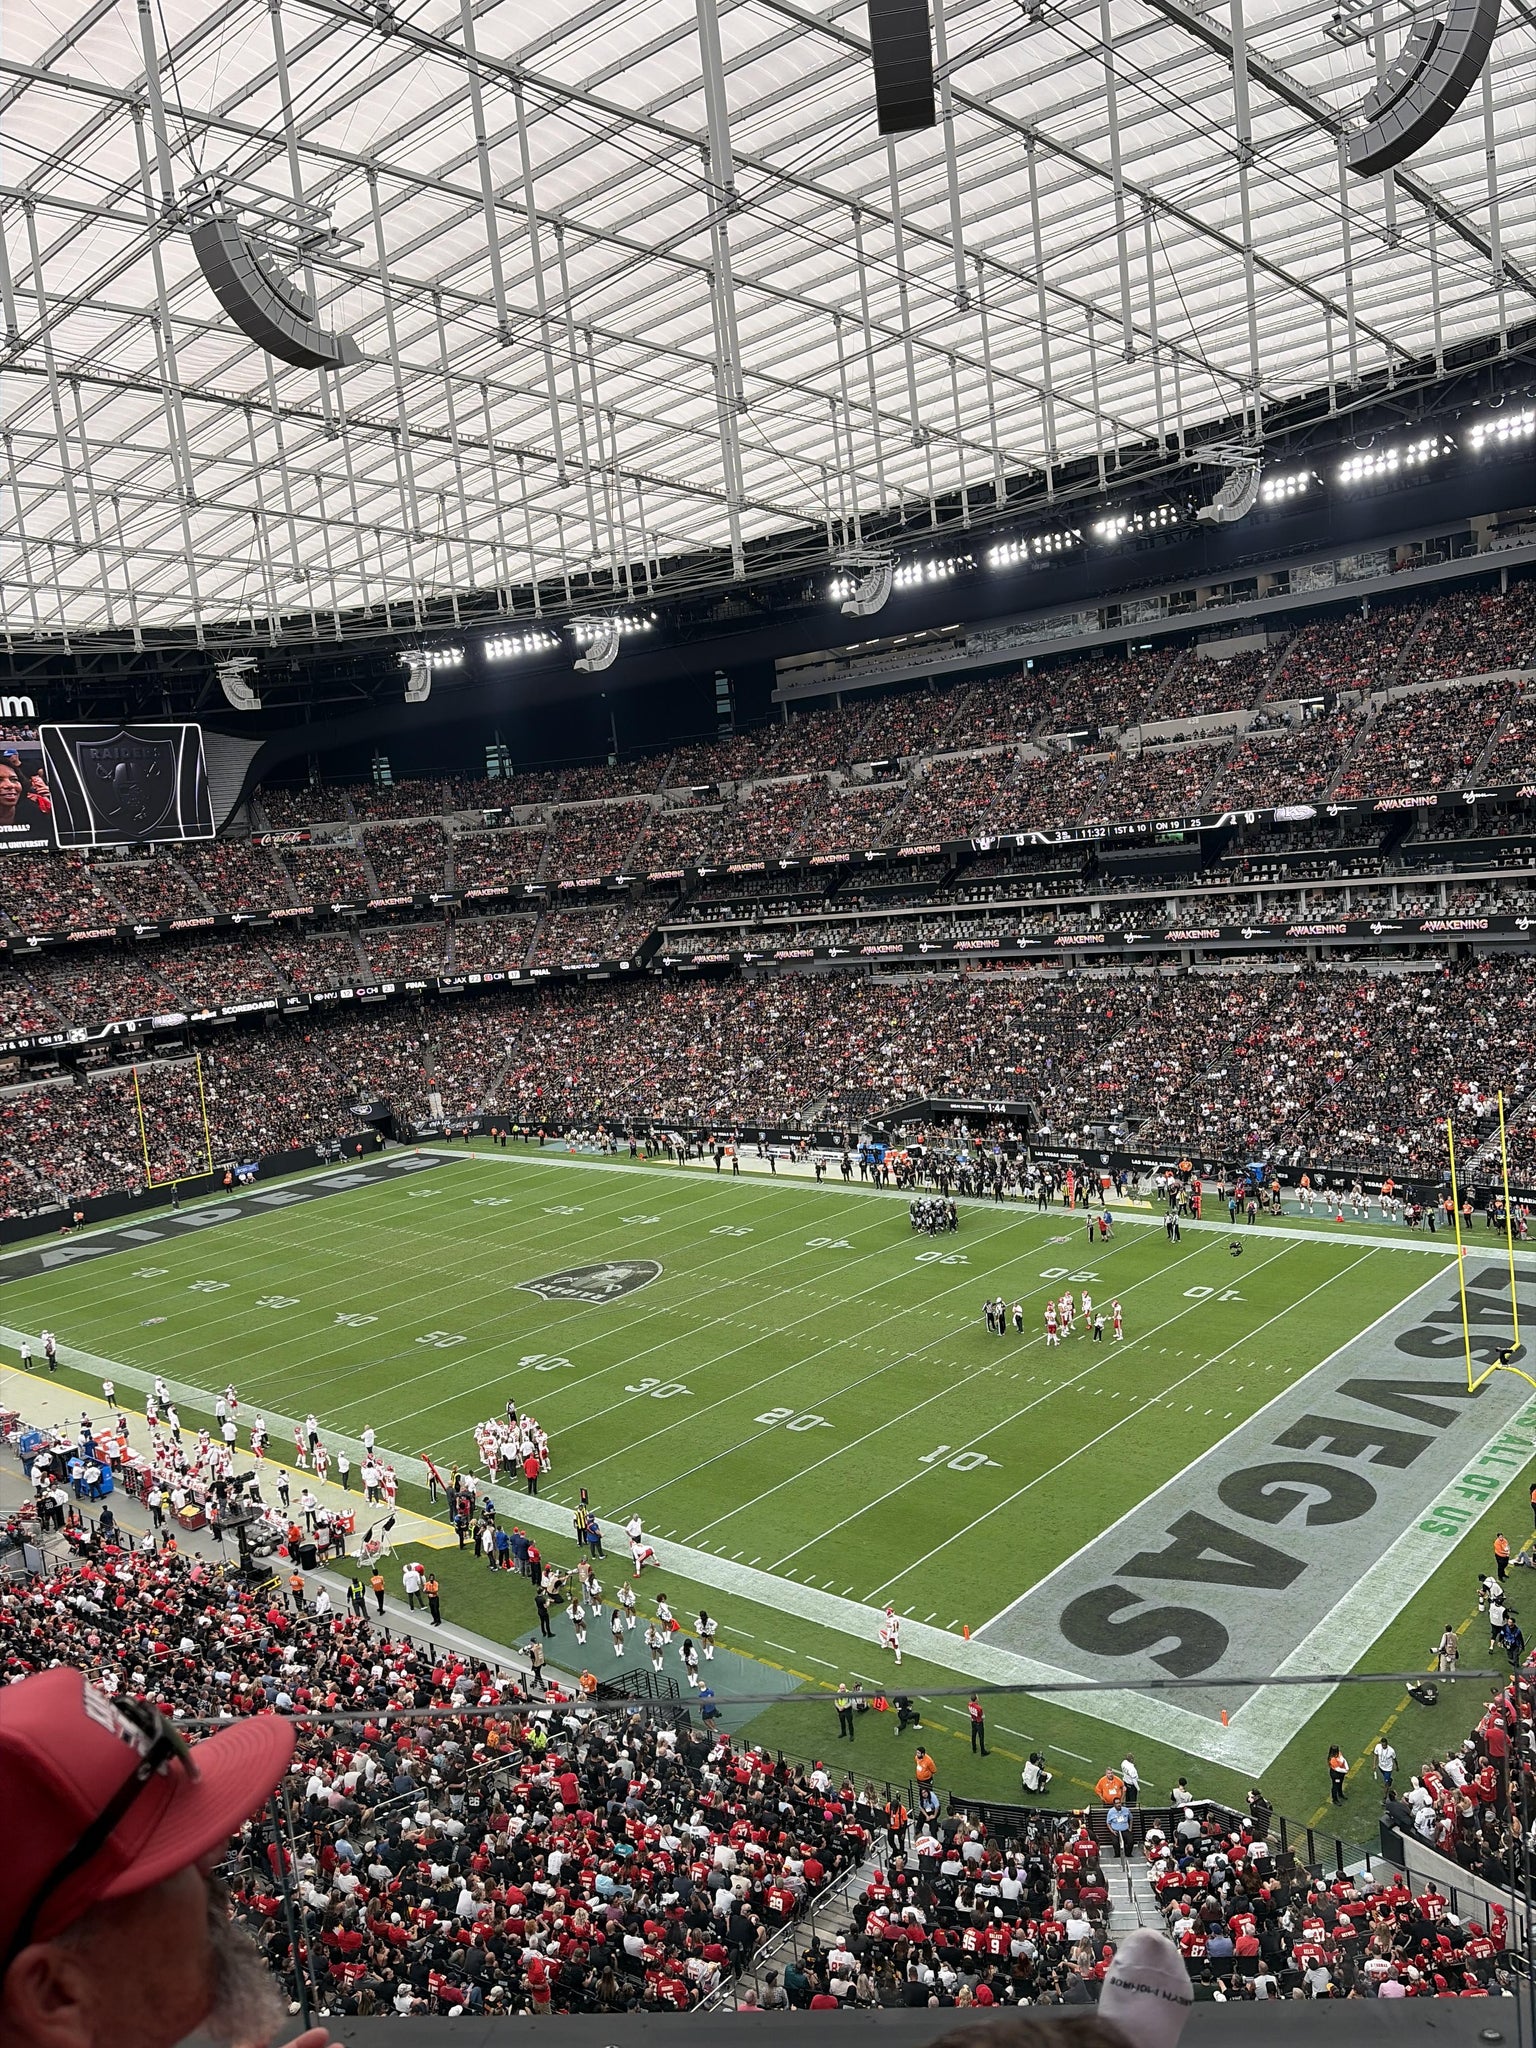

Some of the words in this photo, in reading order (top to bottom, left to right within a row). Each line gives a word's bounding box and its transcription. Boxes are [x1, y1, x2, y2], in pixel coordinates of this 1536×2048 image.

[1373, 795, 1438, 812] AWAKENING
[1190, 819, 1201, 827] 25
[1245, 812, 1255, 824] 10
[1114, 826, 1128, 835] 1ST
[1137, 824, 1147, 832] 10
[1156, 822, 1168, 831] ON
[1170, 821, 1180, 829] 19
[1081, 828, 1106, 839] 11:32
[8, 839, 49, 849] UNIVERSITY
[897, 844, 941, 857] AWAKENING
[809, 854, 850, 866] AWAKENING
[726, 862, 765, 873] AWAKENING
[646, 870, 685, 881] AWAKENING
[557, 878, 601, 890] AWAKENING
[464, 887, 509, 898] AWAKENING
[367, 897, 413, 908] AWAKENING
[267, 907, 314, 918] AWAKENING
[169, 917, 215, 930] AWAKENING
[1419, 918, 1488, 933] AWAKENING
[66, 928, 117, 941] AWAKENING
[1164, 929, 1220, 942] AWAKENING
[1285, 924, 1347, 938] AWAKENING
[953, 939, 1000, 951] AWAKENING
[1054, 934, 1104, 947] AWAKENING
[774, 949, 814, 960] AWAKENING
[860, 944, 904, 956] AWAKENING
[691, 954, 730, 964] AWAKENING
[529, 969, 551, 977] FINAL
[405, 981, 427, 990] FINAL
[453, 976, 467, 985] JAX
[323, 992, 338, 1000] NYJ
[366, 987, 379, 995] CHI
[221, 999, 276, 1015] SCOREBOARD
[286, 997, 301, 1005] NFL
[126, 1022, 136, 1032] 10
[18, 1040, 29, 1048] 10
[38, 1036, 52, 1045] ON
[53, 1034, 63, 1043] 19
[987, 1103, 1006, 1113] 1:44
[1495, 1194, 1518, 1202] VEAS
[709, 1225, 754, 1236] 50
[1039, 1267, 1098, 1282] 20
[530, 1283, 606, 1299] RAIDERS
[1182, 1286, 1240, 1301] 10
[258, 1295, 301, 1309] 30
[334, 1312, 379, 1327] 40
[414, 1330, 467, 1348] 50
[517, 1353, 565, 1372] 40
[624, 1377, 685, 1399] 30
[753, 1407, 824, 1432] 20
[1478, 1433, 1533, 1466] ALL
[917, 1445, 989, 1471] 10
[1454, 1473, 1500, 1502] OF
[1418, 1505, 1474, 1537] US
[1060, 1378, 1492, 1679] VEGAS
[468, 1796, 480, 1807] 26
[675, 1802, 682, 1814] 9
[507, 1825, 516, 1837] 15
[769, 1896, 783, 1912] 29
[1427, 1905, 1441, 1920] 15
[962, 1933, 977, 1951] 95
[991, 1939, 1000, 1954] 9
[1191, 1944, 1205, 1957] 87
